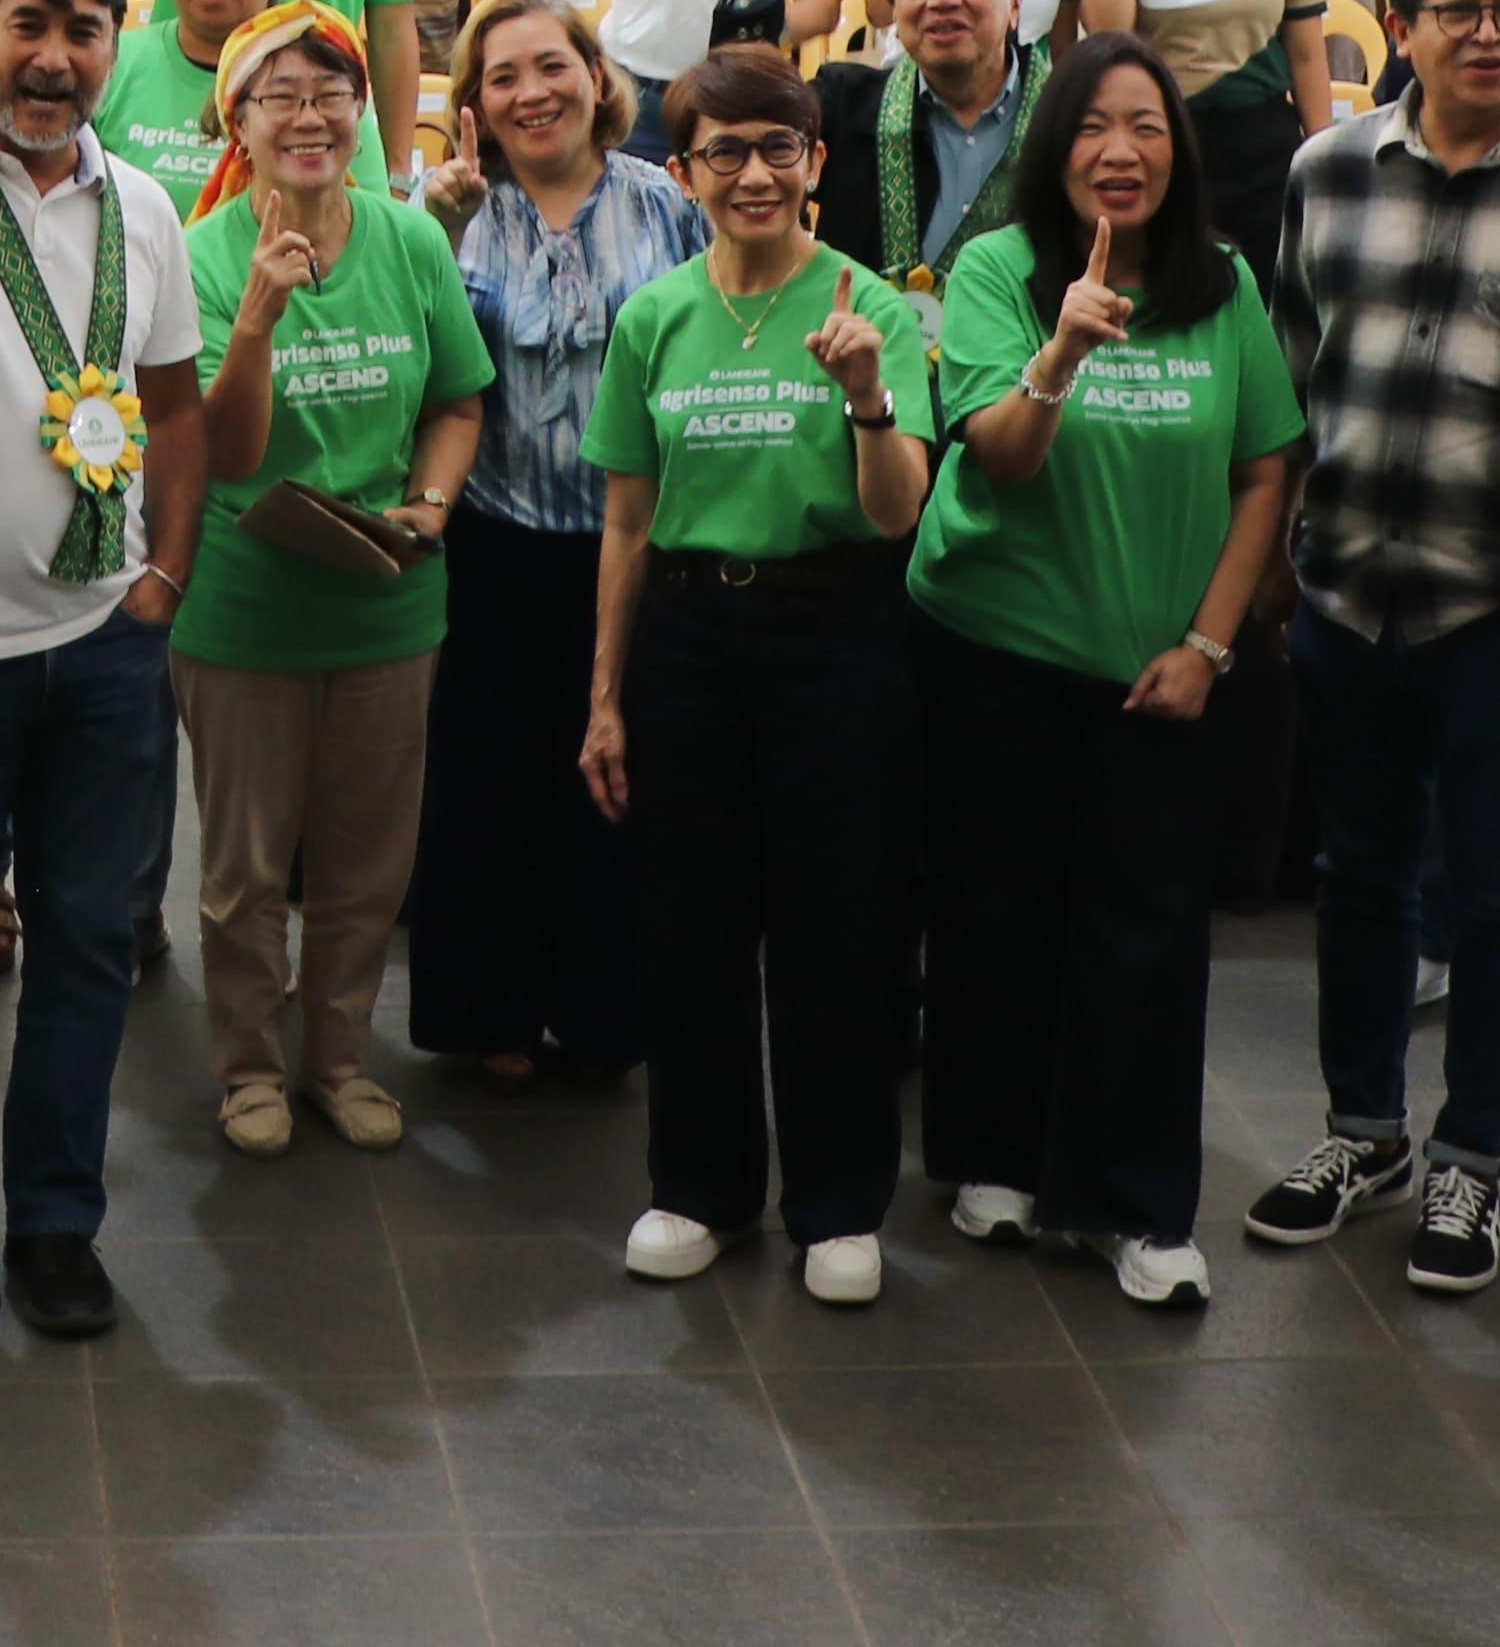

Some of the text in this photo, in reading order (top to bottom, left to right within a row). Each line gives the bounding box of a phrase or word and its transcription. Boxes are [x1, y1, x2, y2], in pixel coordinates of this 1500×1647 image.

[272, 333, 413, 373] grisenso Plus
[284, 366, 390, 397] ASCEND
[1078, 357, 1213, 380] risenso Plus
[660, 380, 830, 414] Agrisenso Plus
[1082, 386, 1191, 412] ASCEND
[683, 411, 796, 439] ASCEND
